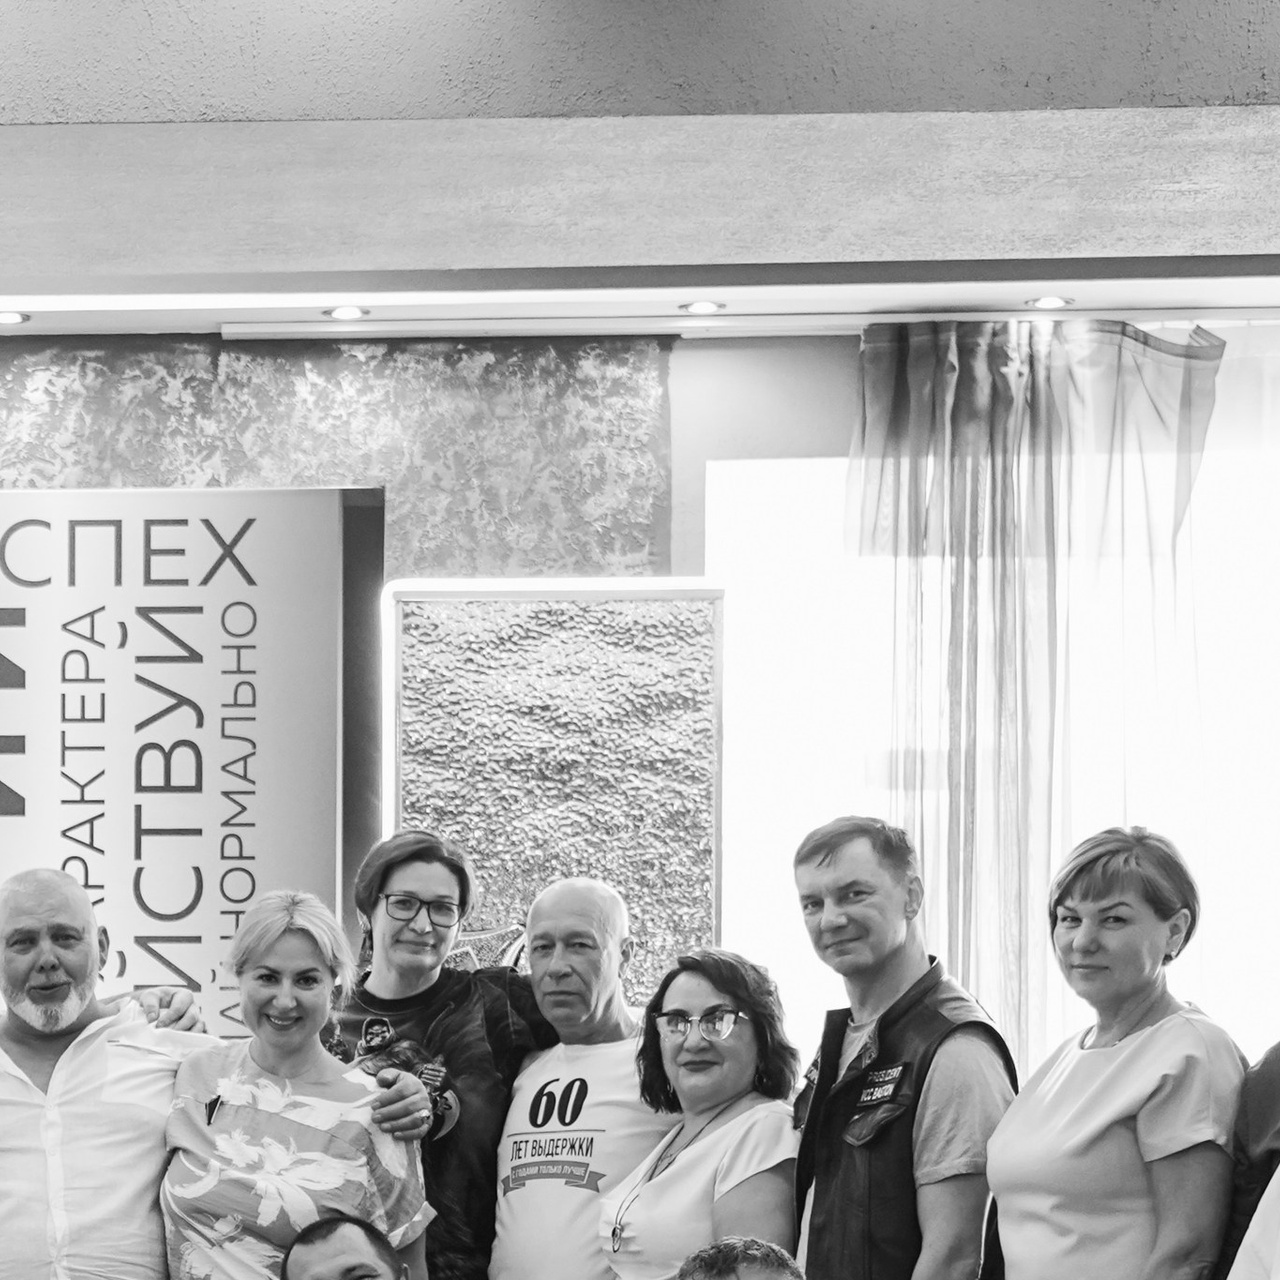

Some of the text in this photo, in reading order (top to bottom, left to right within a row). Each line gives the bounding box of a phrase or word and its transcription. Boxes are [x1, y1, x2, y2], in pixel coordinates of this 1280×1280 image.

[116, 606, 204, 992] ЙСТВУЙ
[529, 1077, 588, 1128] 60
[510, 1137, 594, 1161] ЛЕТ ВЫДЕРЖКИ
